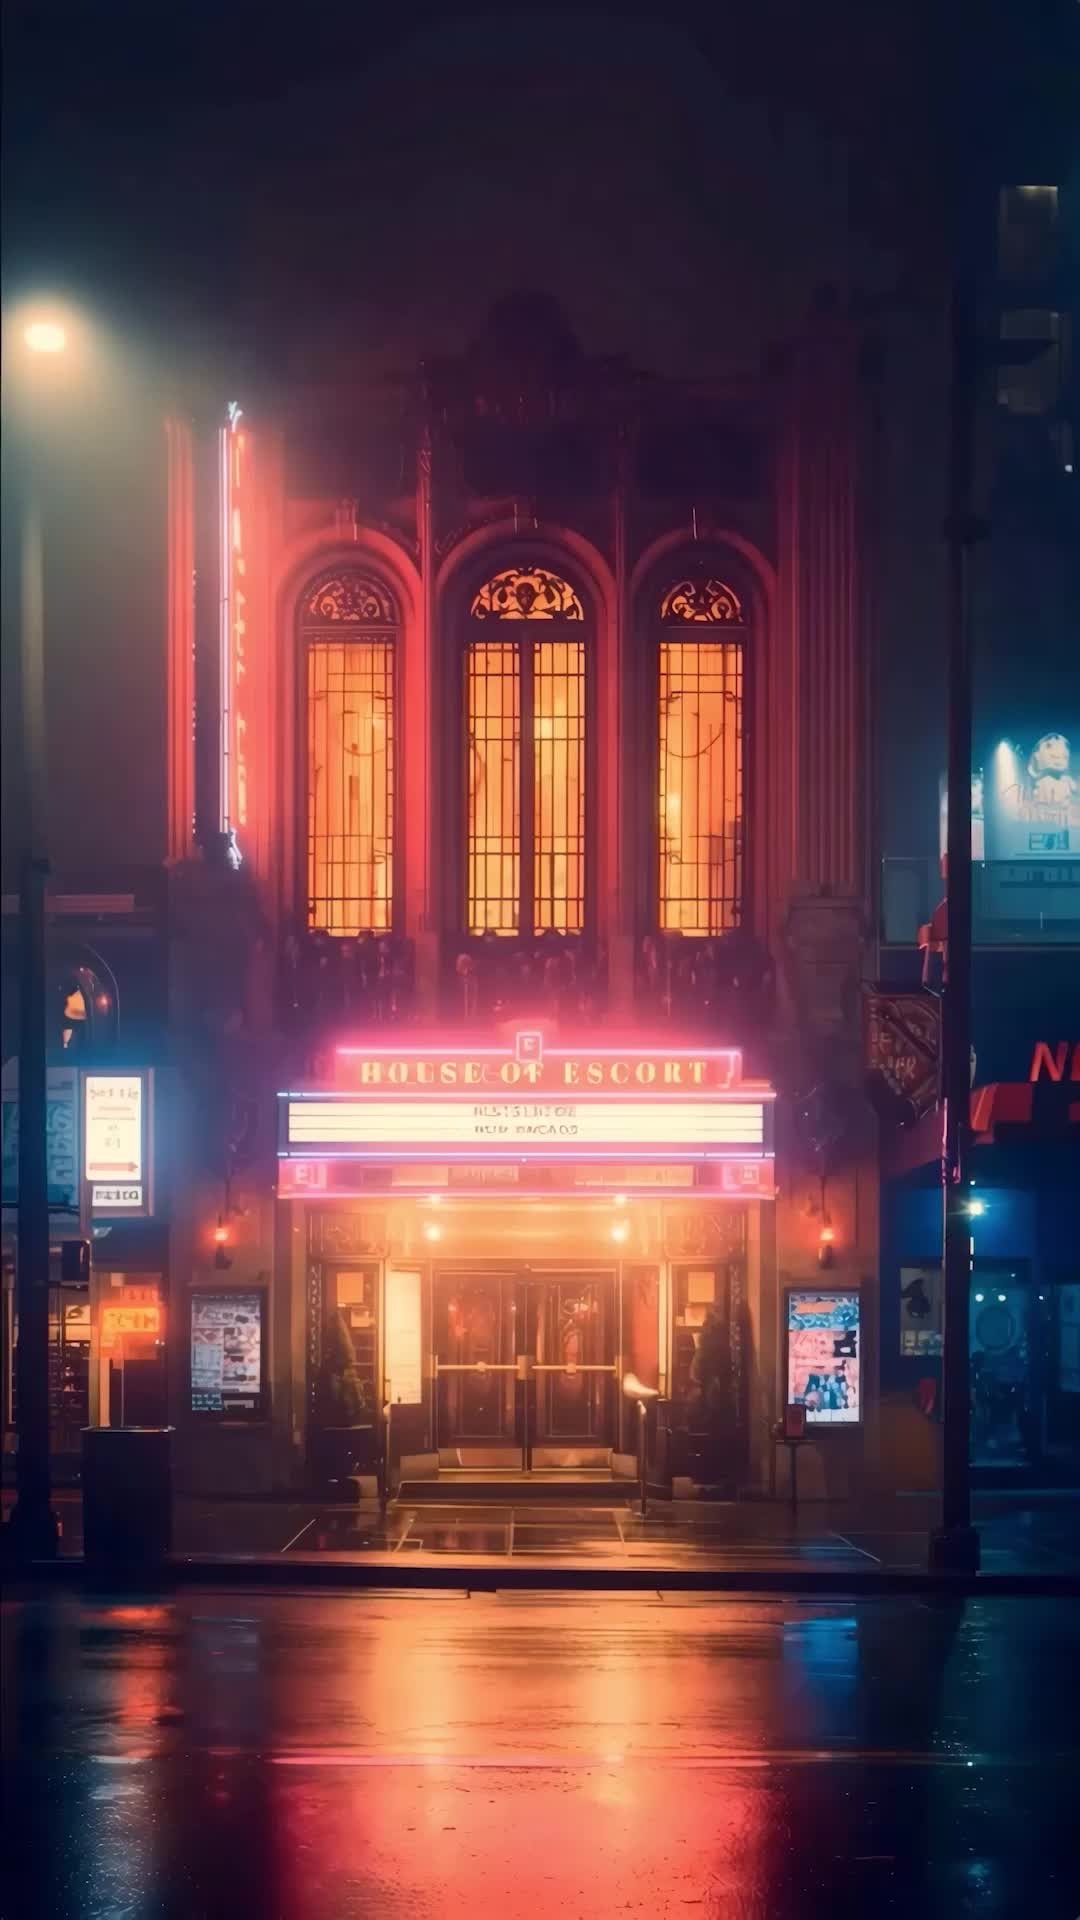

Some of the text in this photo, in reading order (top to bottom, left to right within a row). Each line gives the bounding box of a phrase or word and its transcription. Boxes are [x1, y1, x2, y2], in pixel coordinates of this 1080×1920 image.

[361, 1062, 708, 1084] HOUSE OF ESCORT
